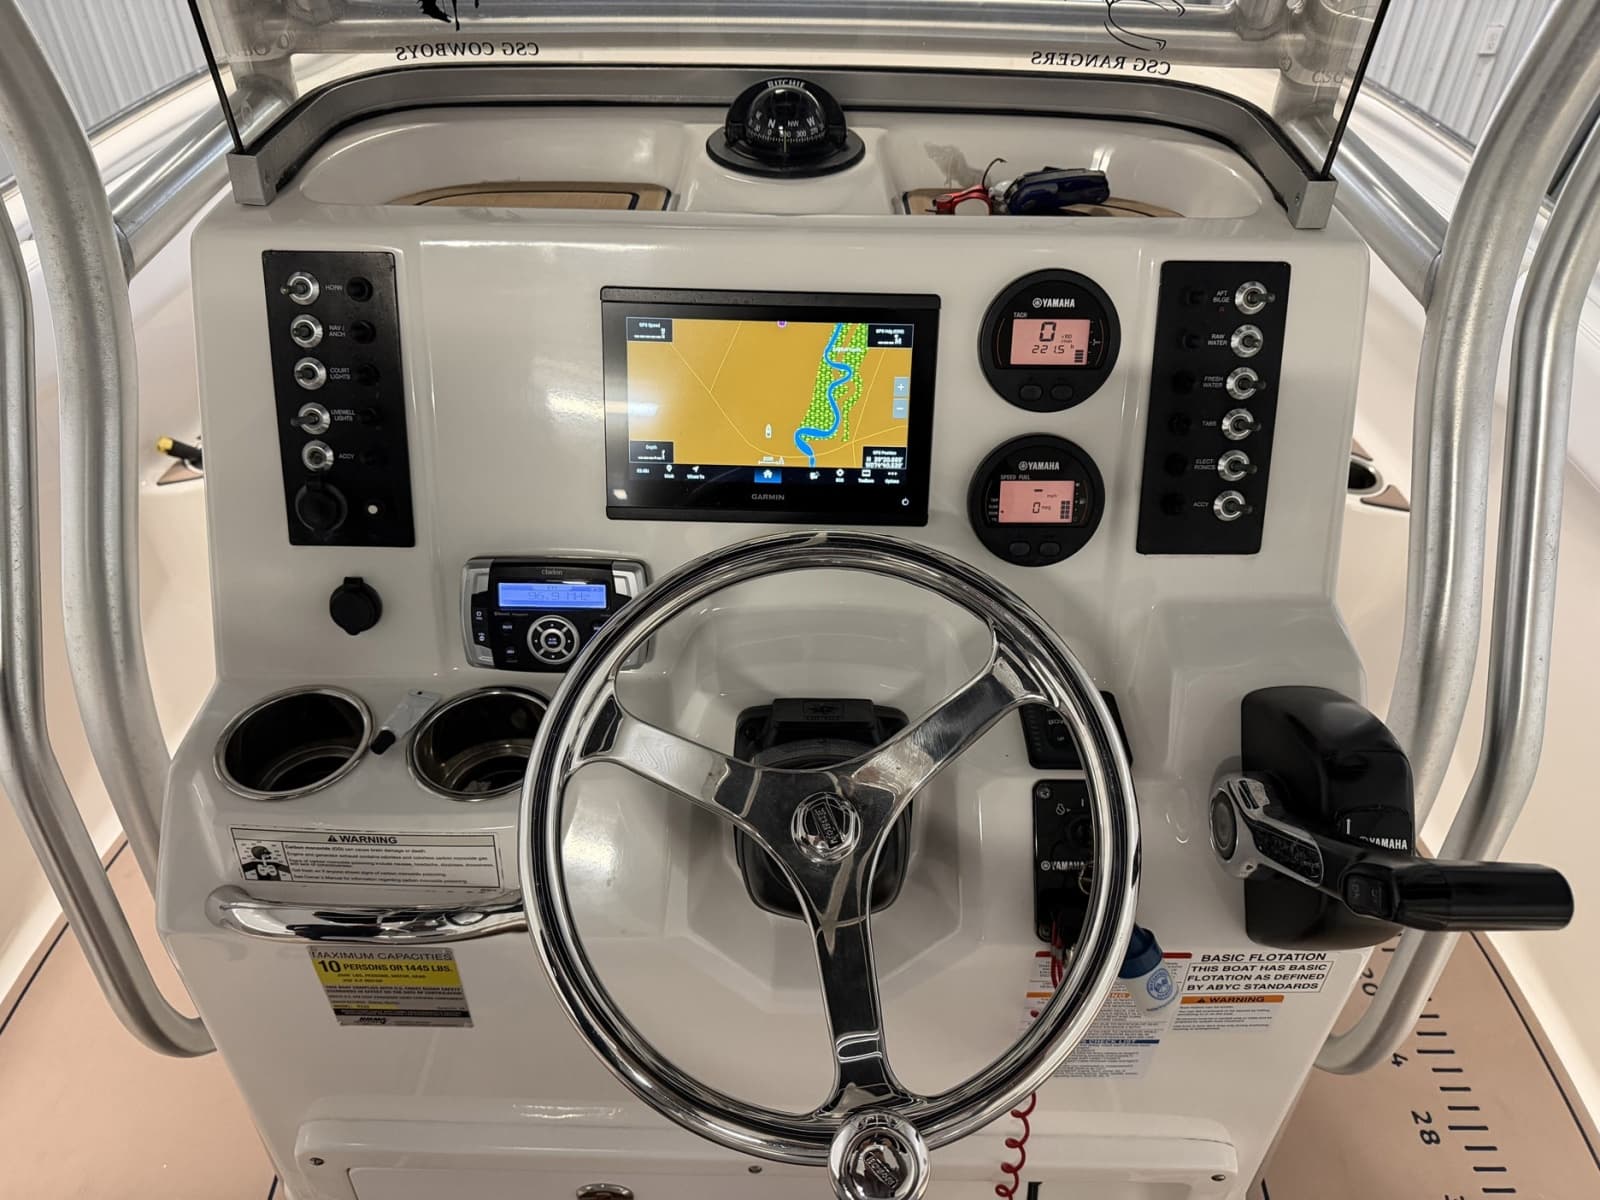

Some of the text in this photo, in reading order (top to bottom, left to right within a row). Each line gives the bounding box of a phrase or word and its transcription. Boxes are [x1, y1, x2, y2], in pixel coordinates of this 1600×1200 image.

[767, 79, 806, 89] RITCHIE
[1042, 298, 1075, 308] YAMAHA
[1039, 321, 1057, 342] 0
[1028, 461, 1060, 471] YAMAHA
[751, 493, 785, 501] GARMIN
[339, 835, 398, 845] WARNING
[1369, 837, 1408, 850] YAMAHA
[312, 951, 453, 961] MAXIMUM CAPACITIES
[1201, 952, 1327, 962] BASIC FLOTATION
[318, 960, 341, 973] 10
[343, 963, 389, 971] PERSONS
[390, 963, 403, 971] OR
[405, 963, 430, 972] 1445
[1288, 963, 1328, 971] BASIC
[1187, 974, 1254, 982] FLOTATION
[1254, 973, 1271, 981] AS
[1206, 983, 1241, 991] ABYC
[1243, 982, 1319, 990] STANDARDS
[1209, 995, 1265, 1004] WARNING
[1410, 1109, 1441, 1146] 28
